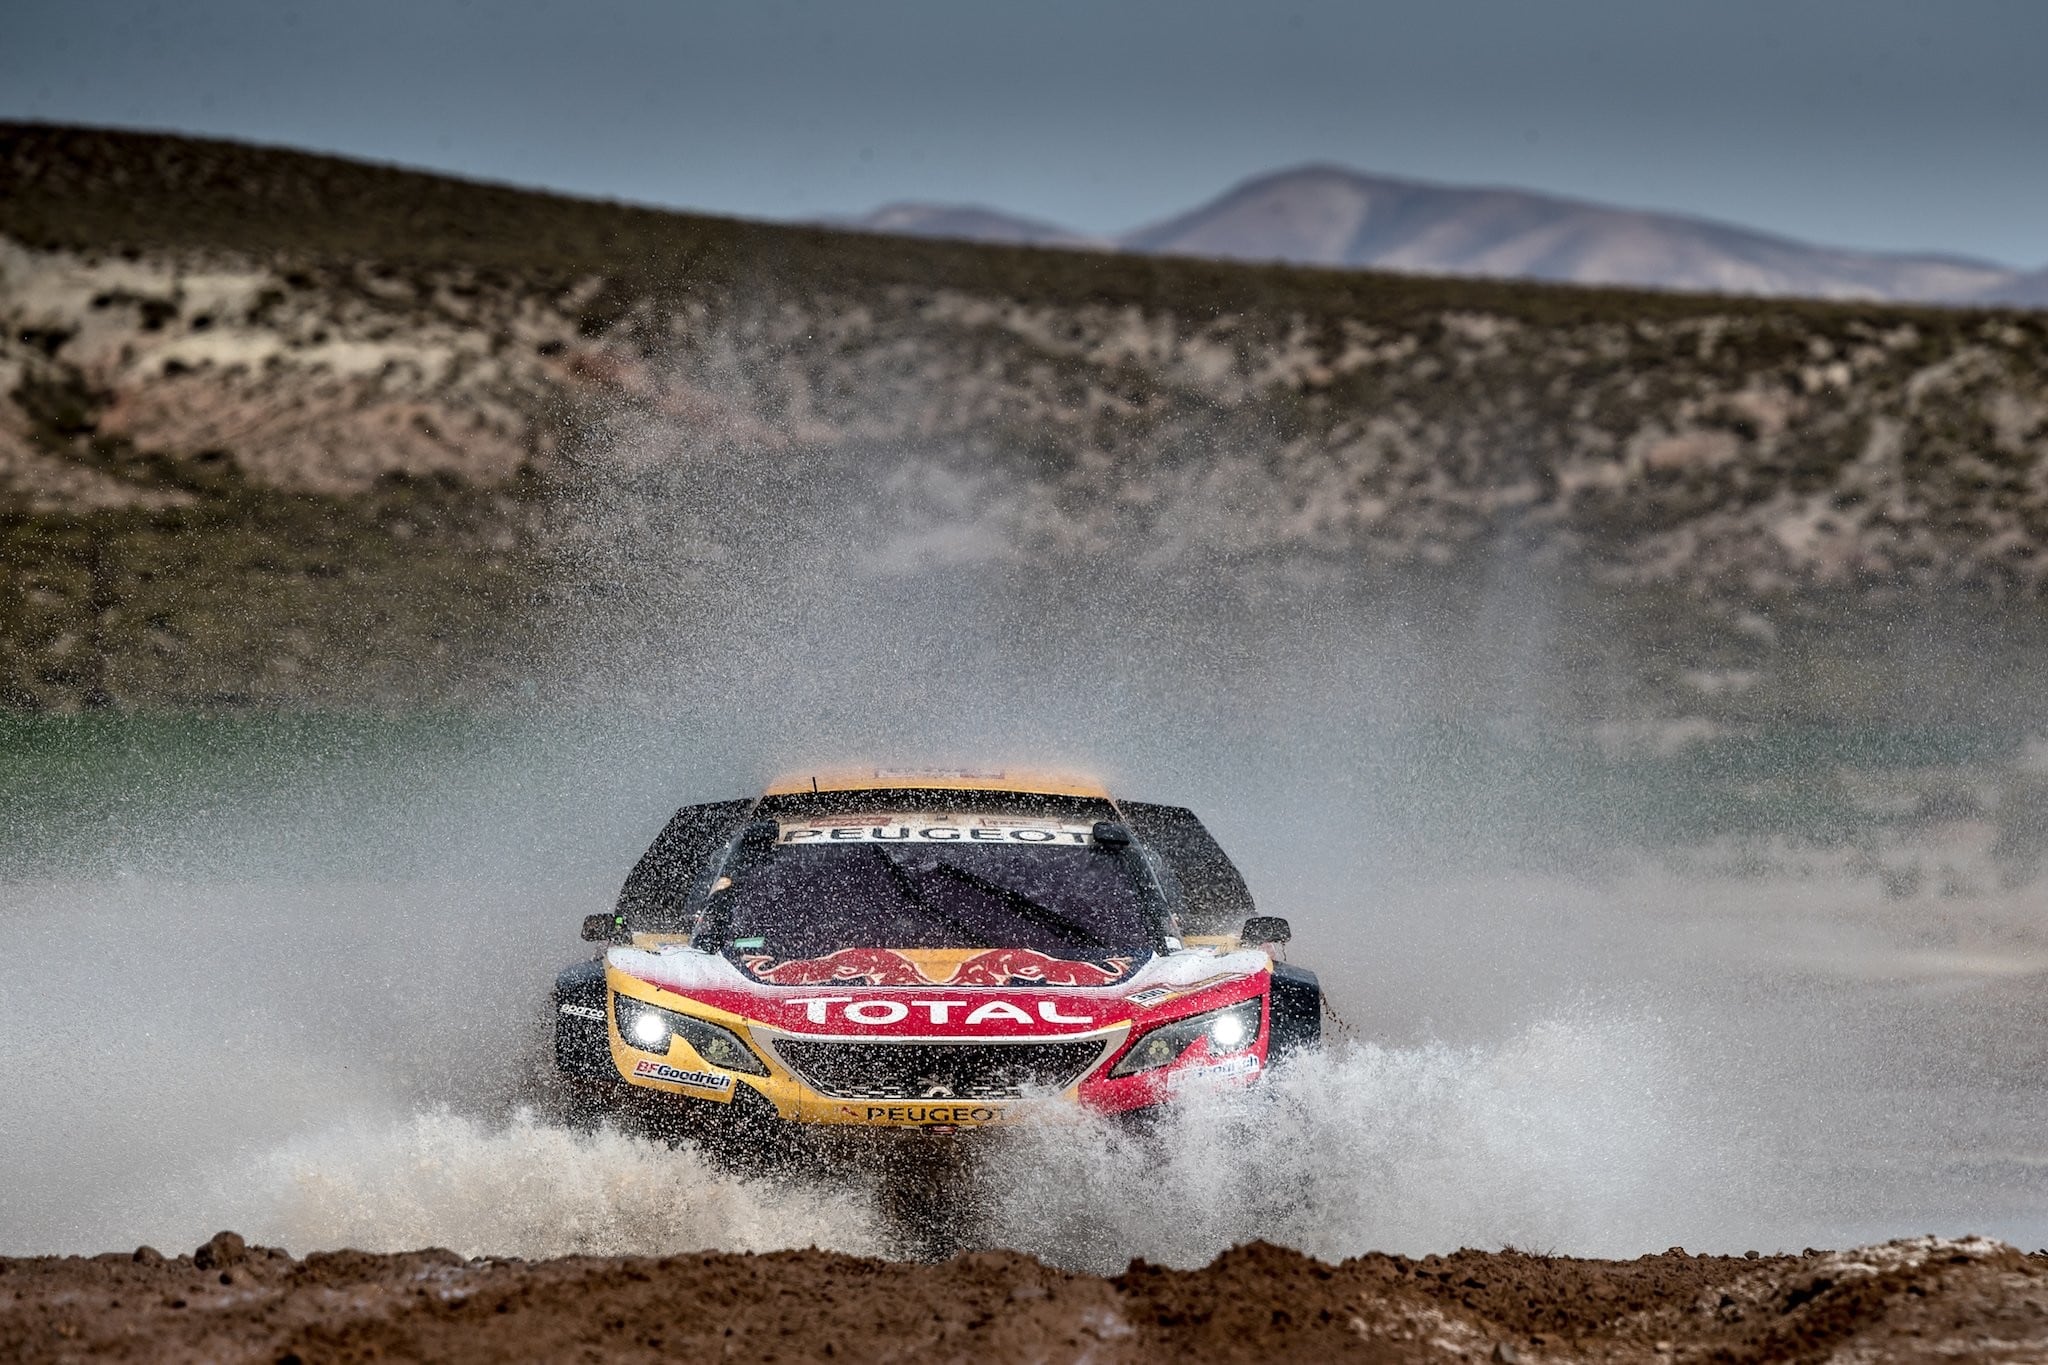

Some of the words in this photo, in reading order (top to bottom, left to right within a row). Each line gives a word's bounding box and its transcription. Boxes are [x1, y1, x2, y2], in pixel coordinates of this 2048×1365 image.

[783, 827, 1094, 843] PEUGEOT
[560, 1003, 605, 1018] sparco
[786, 996, 1094, 1025] TOTAL
[635, 1060, 731, 1087] BFGoodrich
[866, 1106, 1006, 1122] PEUGEOT
